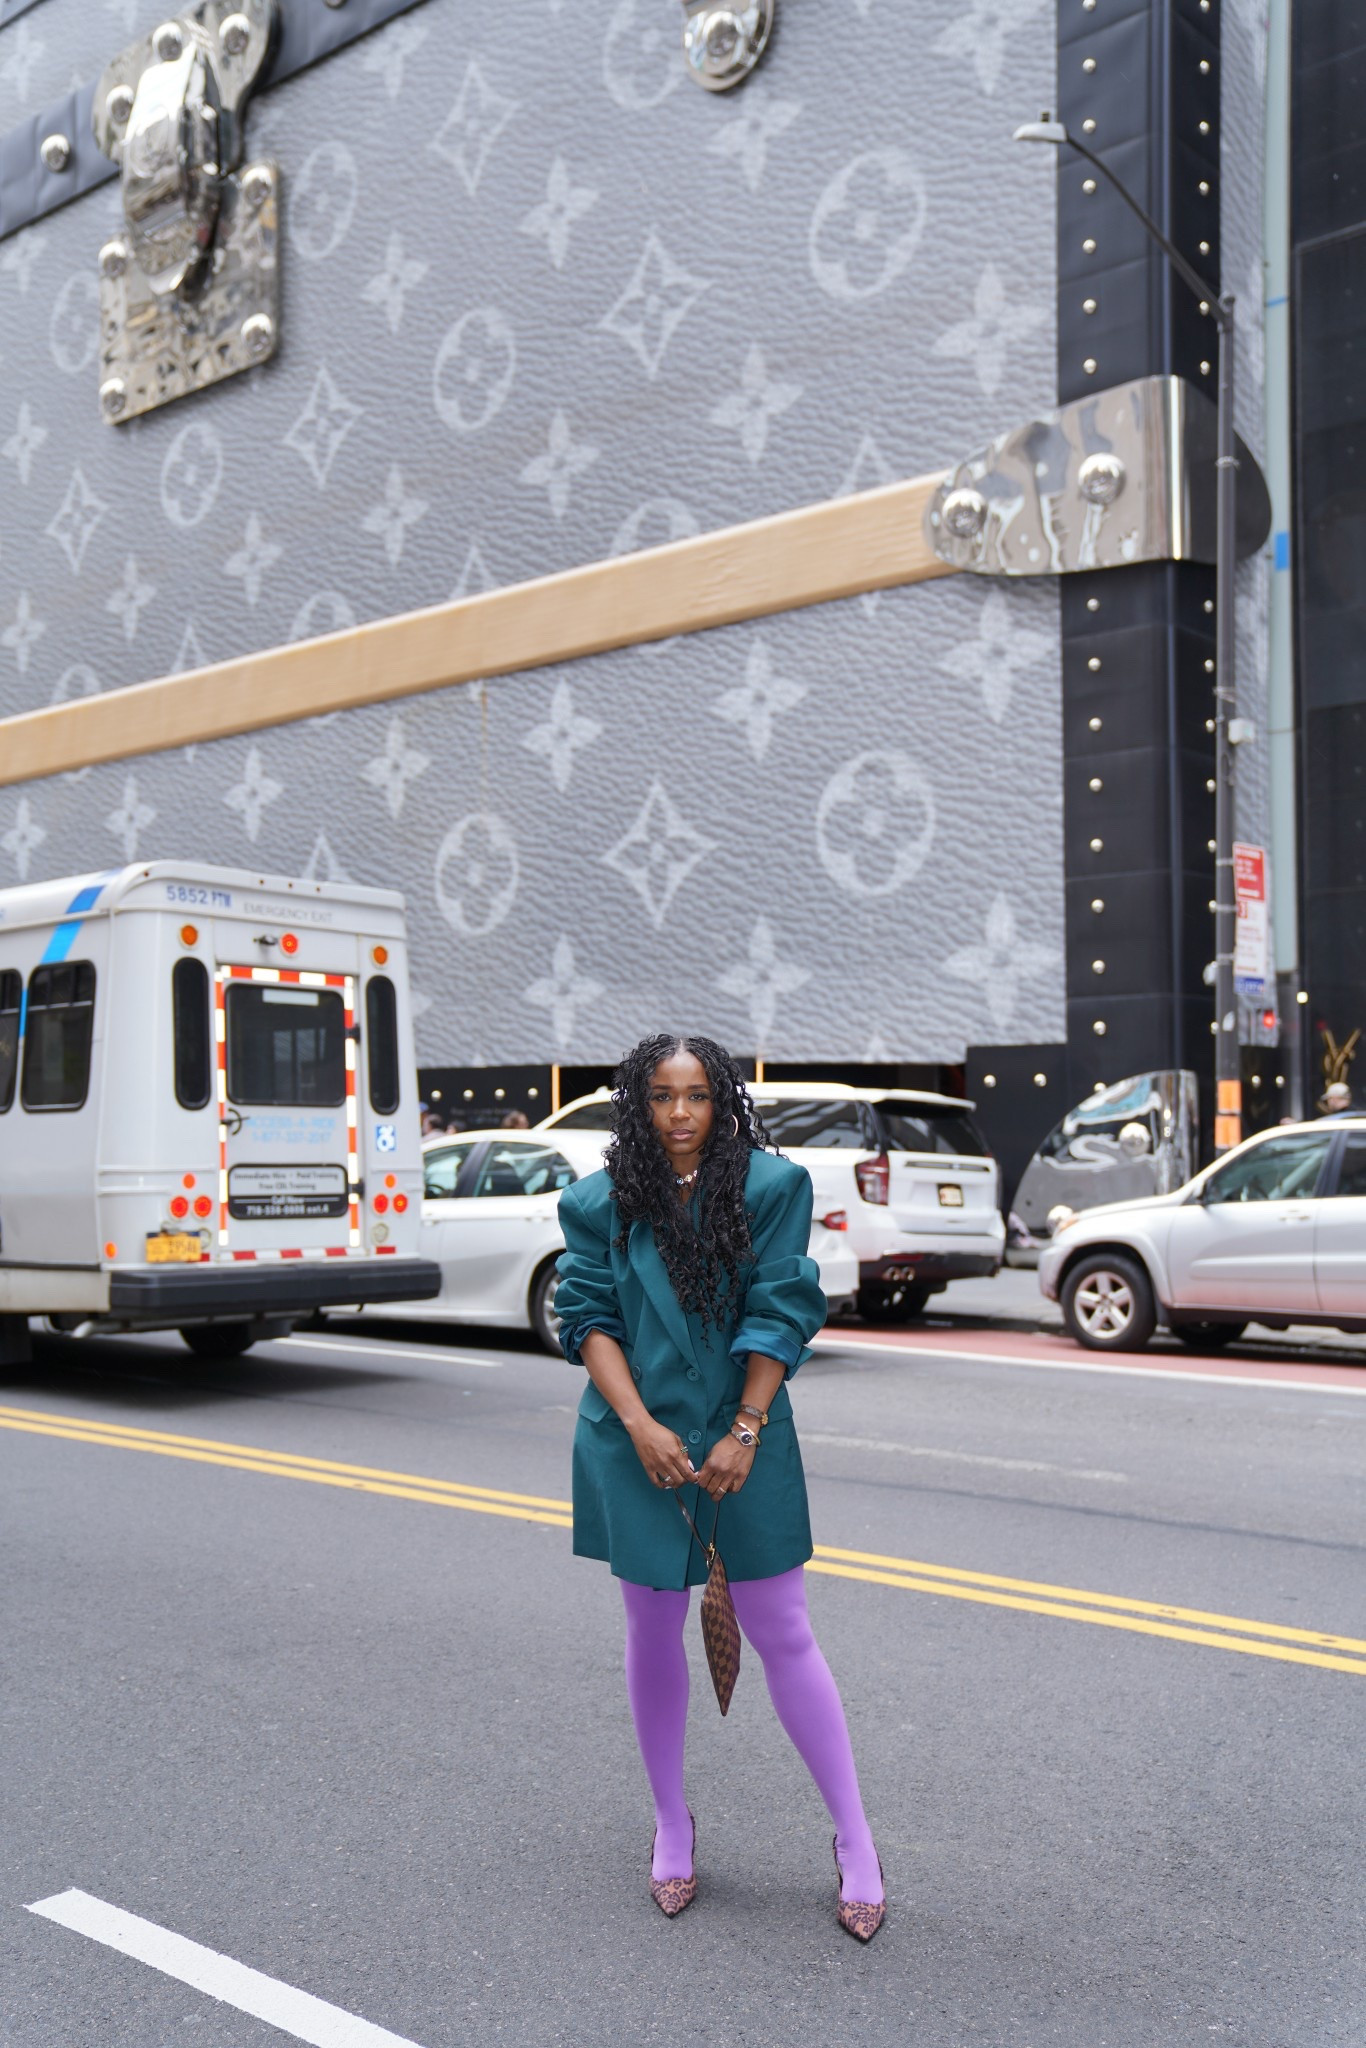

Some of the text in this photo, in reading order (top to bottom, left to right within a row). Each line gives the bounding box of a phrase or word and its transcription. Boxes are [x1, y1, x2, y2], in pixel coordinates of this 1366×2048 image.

[166, 885, 208, 904] 5852
[243, 902, 333, 924] EMERGENCY EXIT
[289, 1183, 315, 1191] Training
